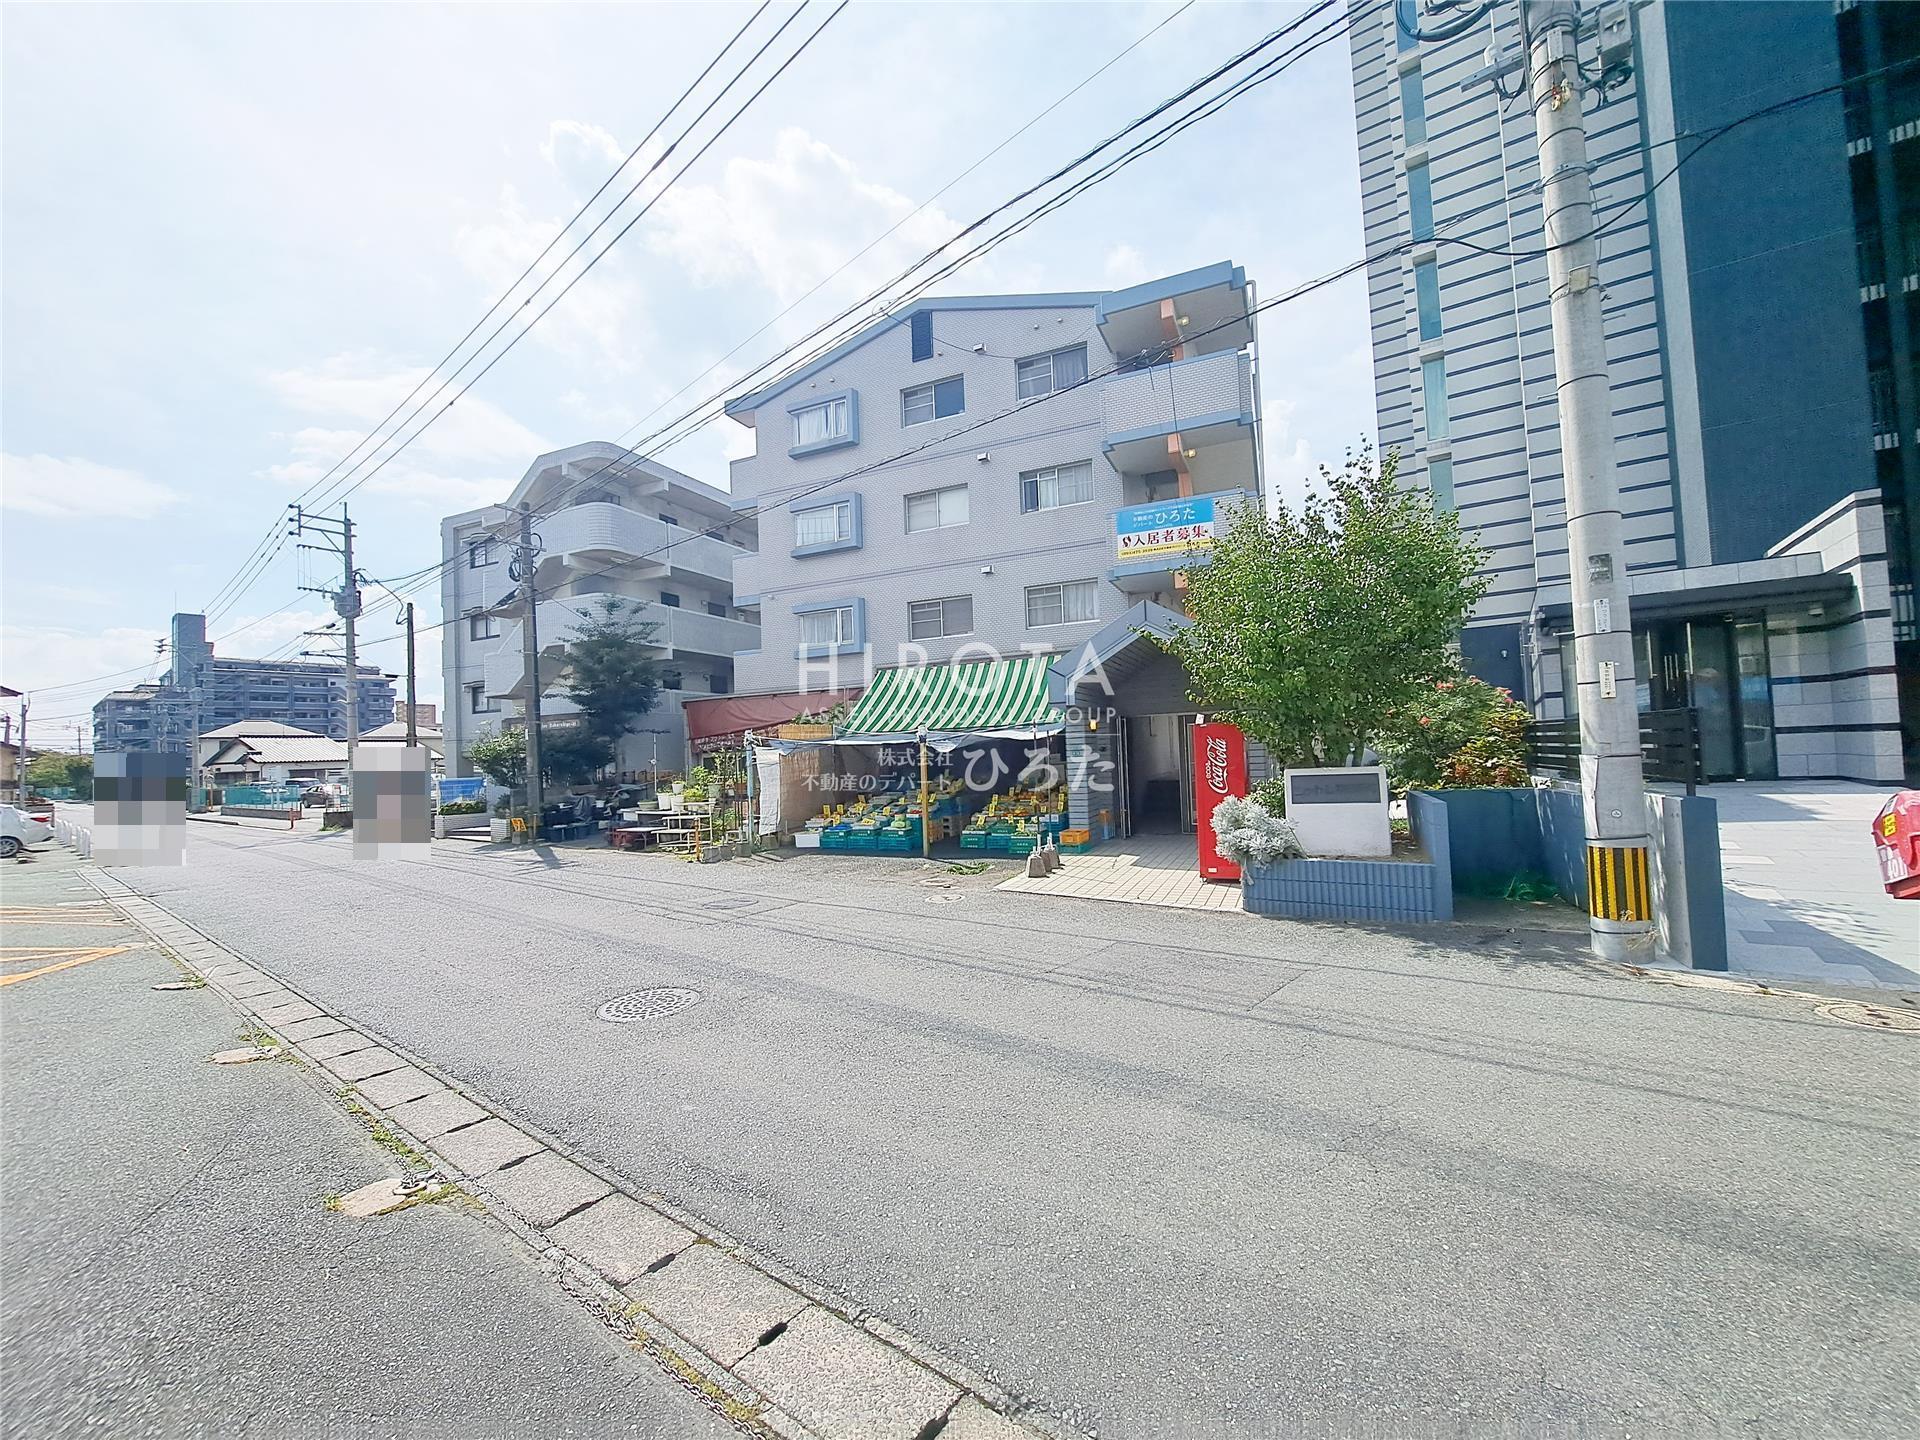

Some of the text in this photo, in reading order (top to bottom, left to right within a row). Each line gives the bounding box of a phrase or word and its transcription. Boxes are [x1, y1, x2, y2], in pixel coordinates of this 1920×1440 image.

[1155, 507, 1195, 524] ひろた
[1133, 525, 1205, 547] 入居者募集
